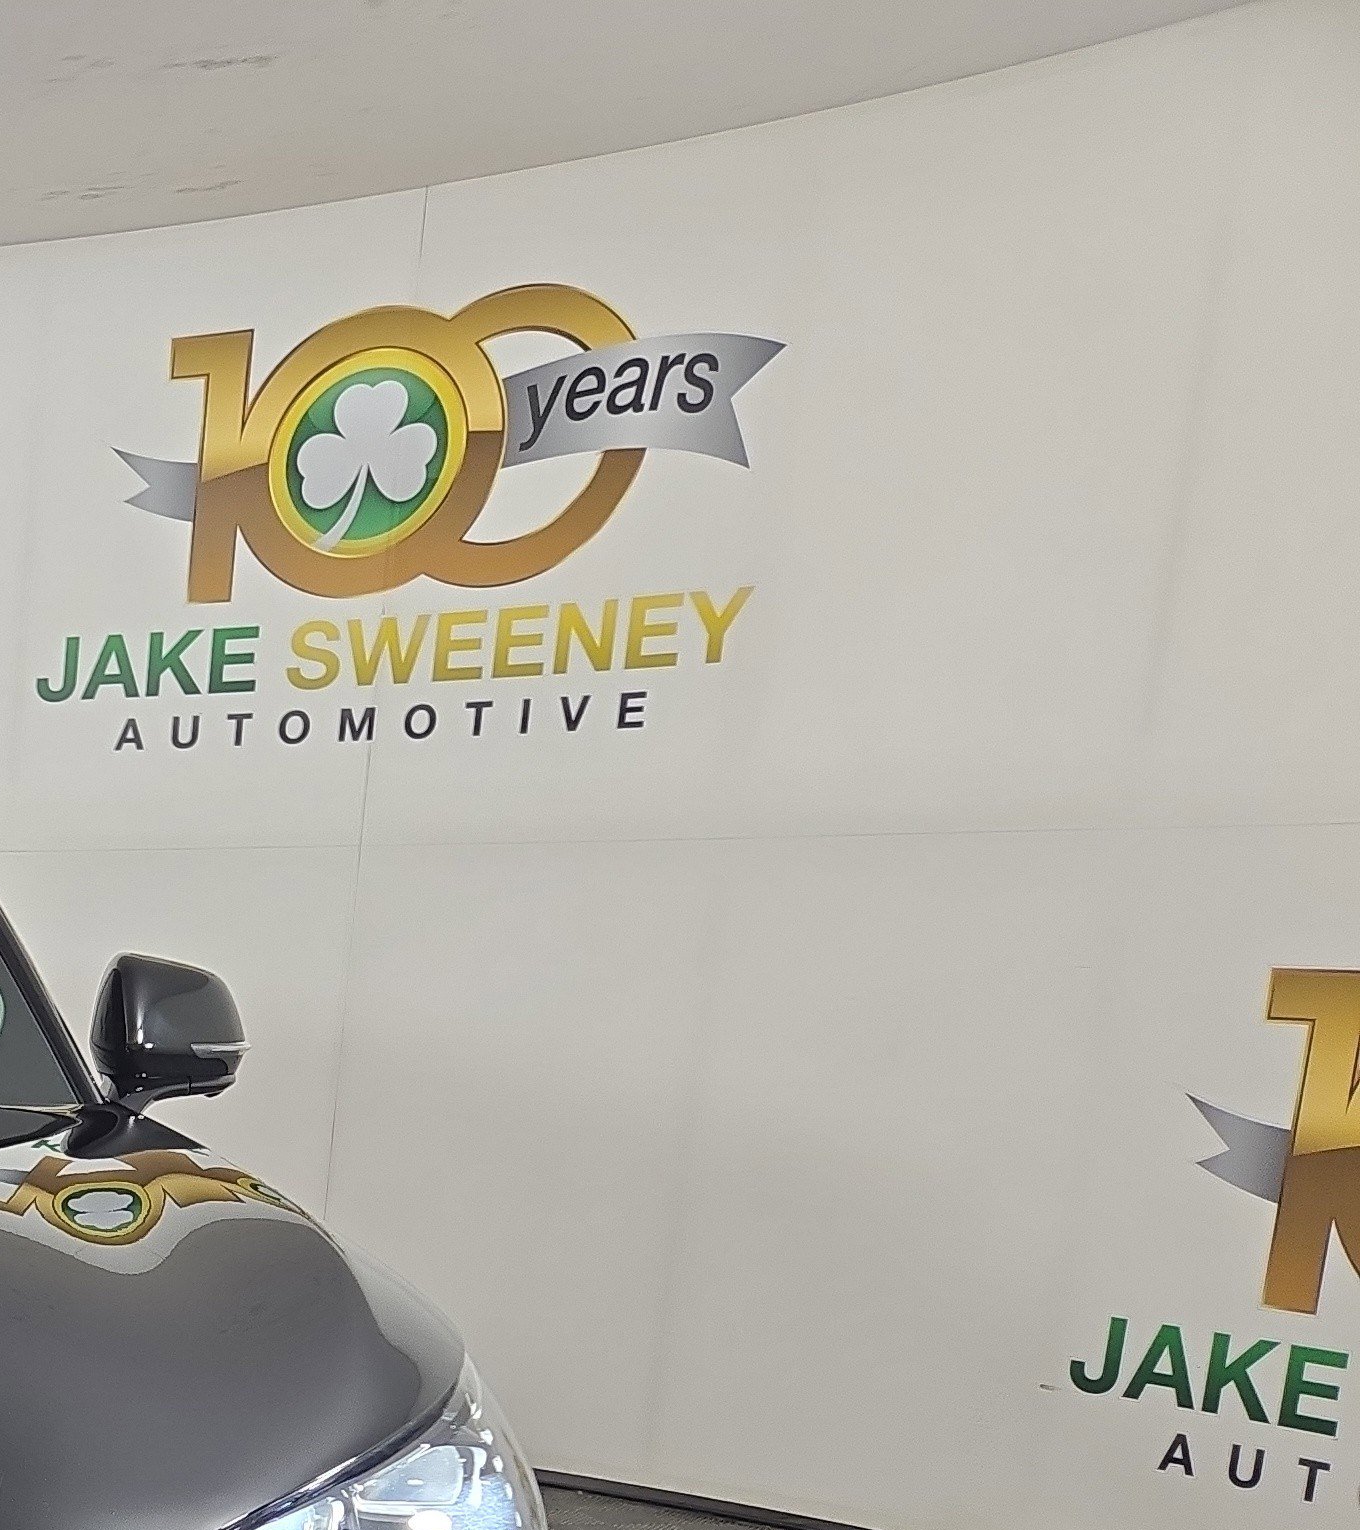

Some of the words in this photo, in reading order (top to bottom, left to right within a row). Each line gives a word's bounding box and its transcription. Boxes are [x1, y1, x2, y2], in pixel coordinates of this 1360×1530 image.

[519, 349, 721, 450] years
[36, 624, 260, 704] JAKE
[286, 584, 757, 692] SWEENEY
[115, 691, 649, 752] AUTOMOTIVE
[1070, 1316, 1349, 1437] JAKE
